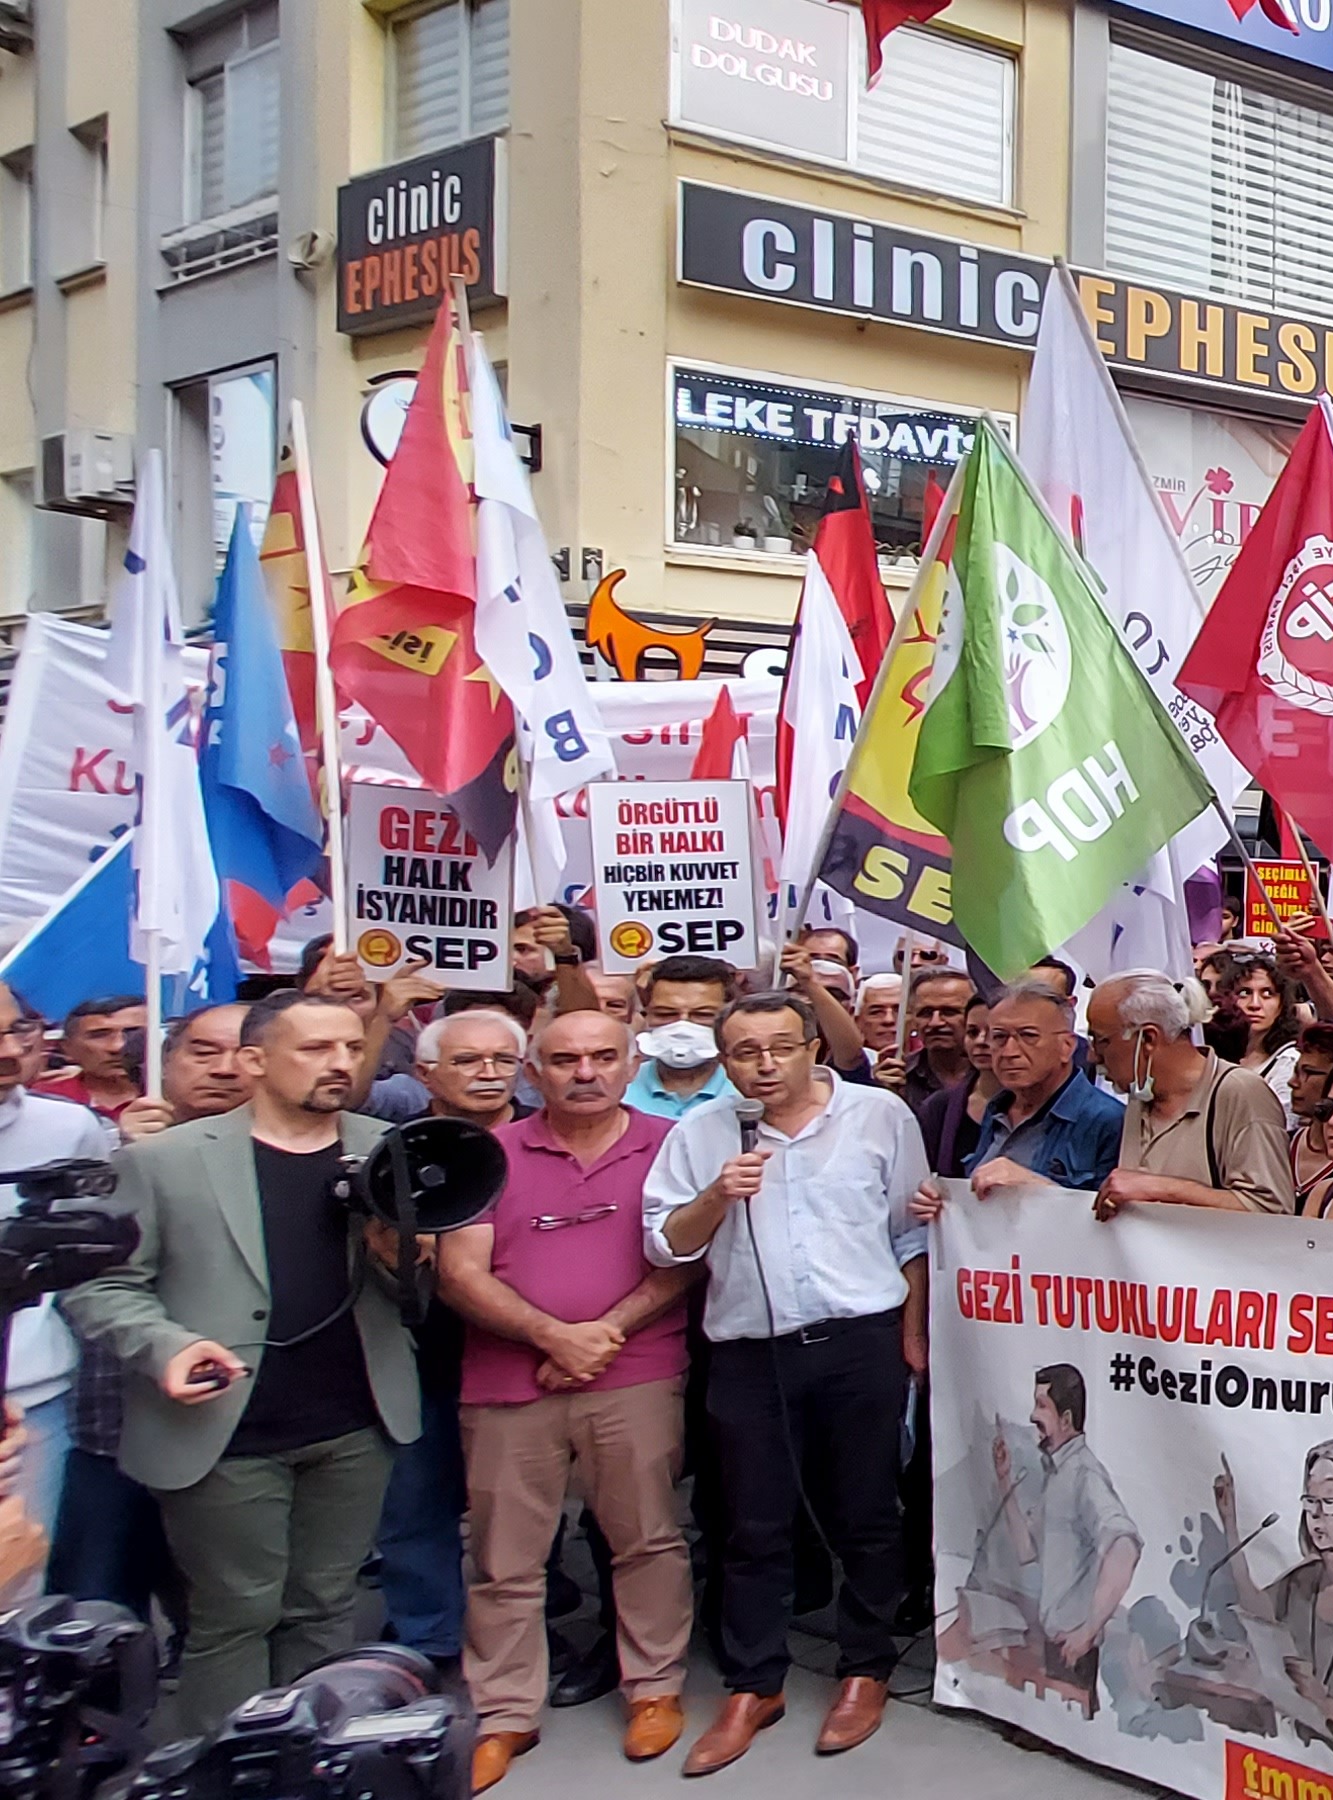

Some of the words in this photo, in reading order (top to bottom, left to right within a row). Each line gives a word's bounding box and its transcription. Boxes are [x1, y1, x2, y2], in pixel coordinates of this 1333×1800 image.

[708, 15, 818, 67] DUDAK
[690, 43, 834, 101] DOLGUSU
[367, 170, 462, 245] clinic
[345, 228, 481, 314] EPHESUS
[741, 217, 1041, 339] clinic
[676, 387, 794, 436] LEKE
[618, 796, 719, 825] ÖRGÜTLÜ
[616, 828, 654, 855] BİR
[660, 830, 725, 854] HALKI
[383, 855, 473, 893] HALK
[603, 861, 665, 888] HİÇBİR
[670, 861, 739, 882] KUVVET
[356, 883, 498, 929] İSYANIDIR
[622, 887, 724, 912] YENEMEZ!
[405, 935, 499, 970] SEP
[657, 918, 745, 954] SEP
[956, 1254, 1025, 1325] GEZİ
[1030, 1272, 1279, 1351] TUTUKLULARI
